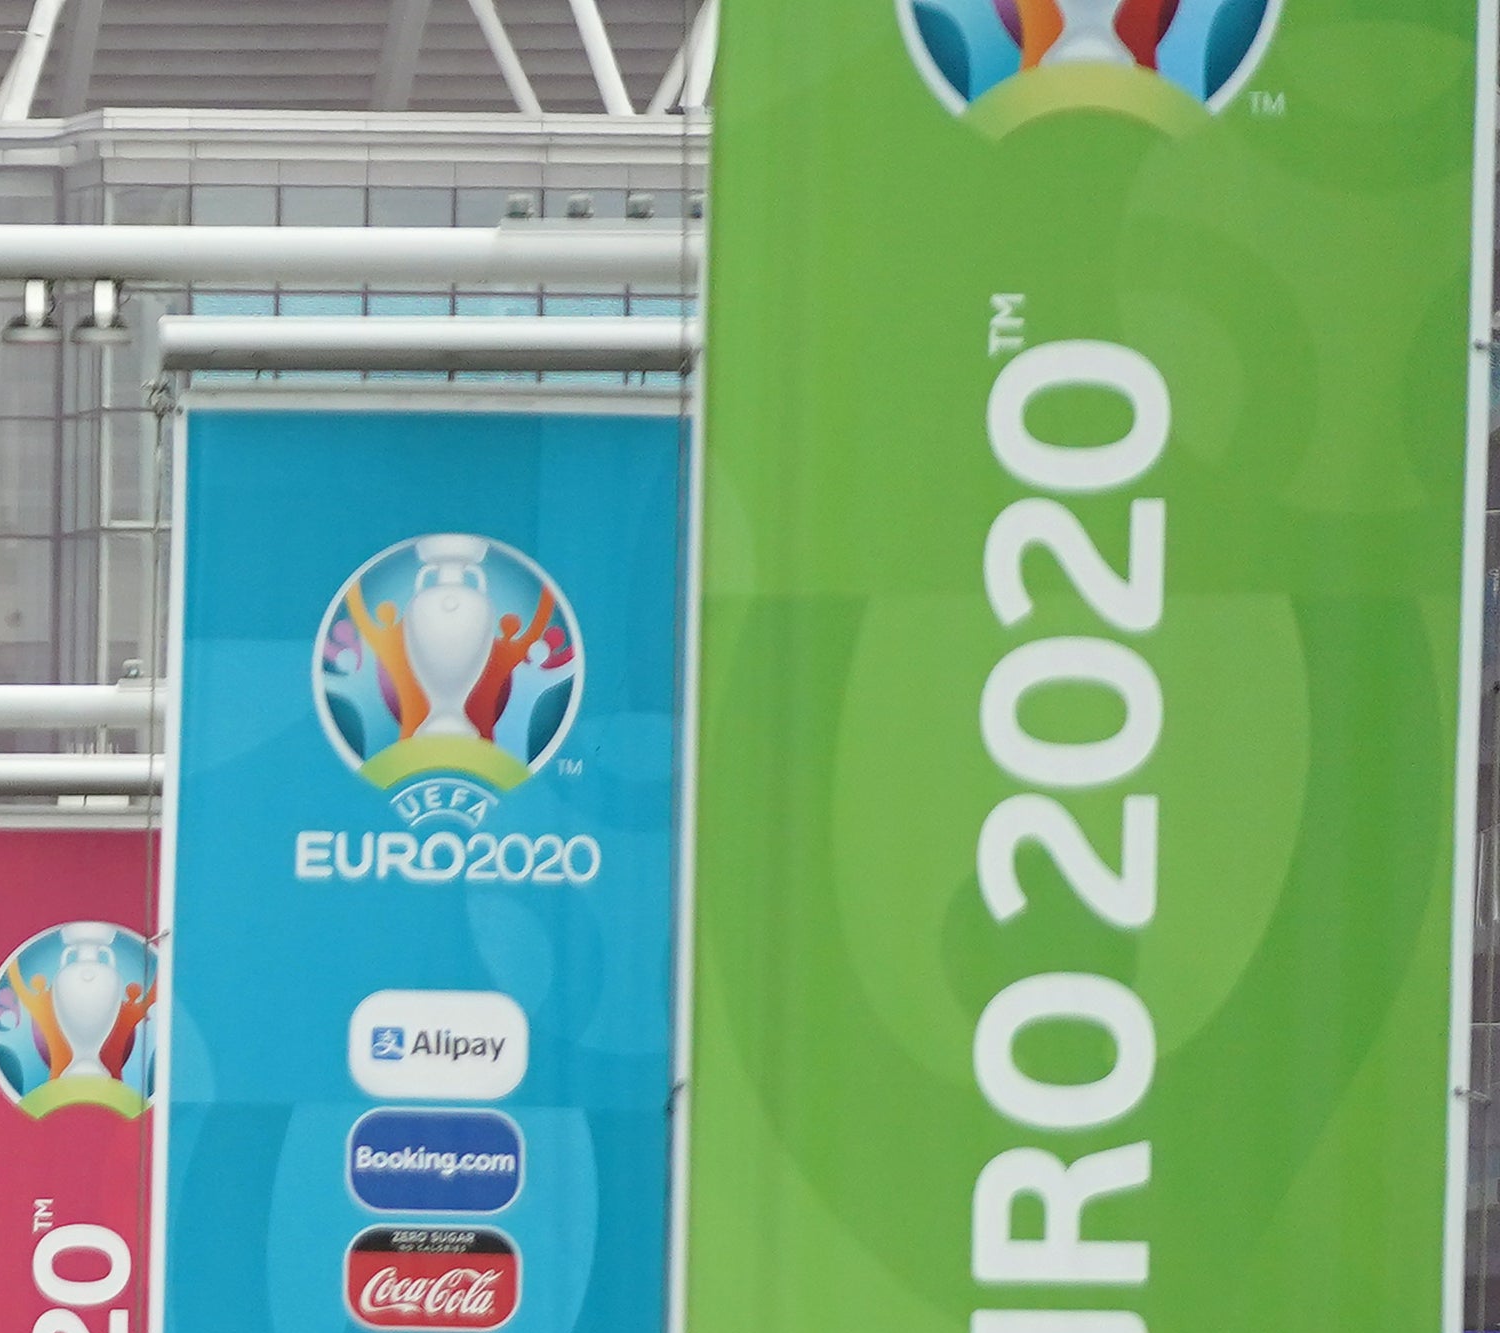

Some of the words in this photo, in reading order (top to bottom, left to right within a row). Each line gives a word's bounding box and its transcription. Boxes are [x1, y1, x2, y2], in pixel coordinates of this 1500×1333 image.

[976, 337, 1171, 930] 2020
[397, 781, 487, 824] UEFA
[411, 1028, 506, 1062] Alipay
[355, 1145, 516, 1178] Booking.com
[391, 1231, 429, 1244] ZERO
[432, 1231, 475, 1245] SUGAR
[358, 1264, 504, 1316] Coca-Cola
